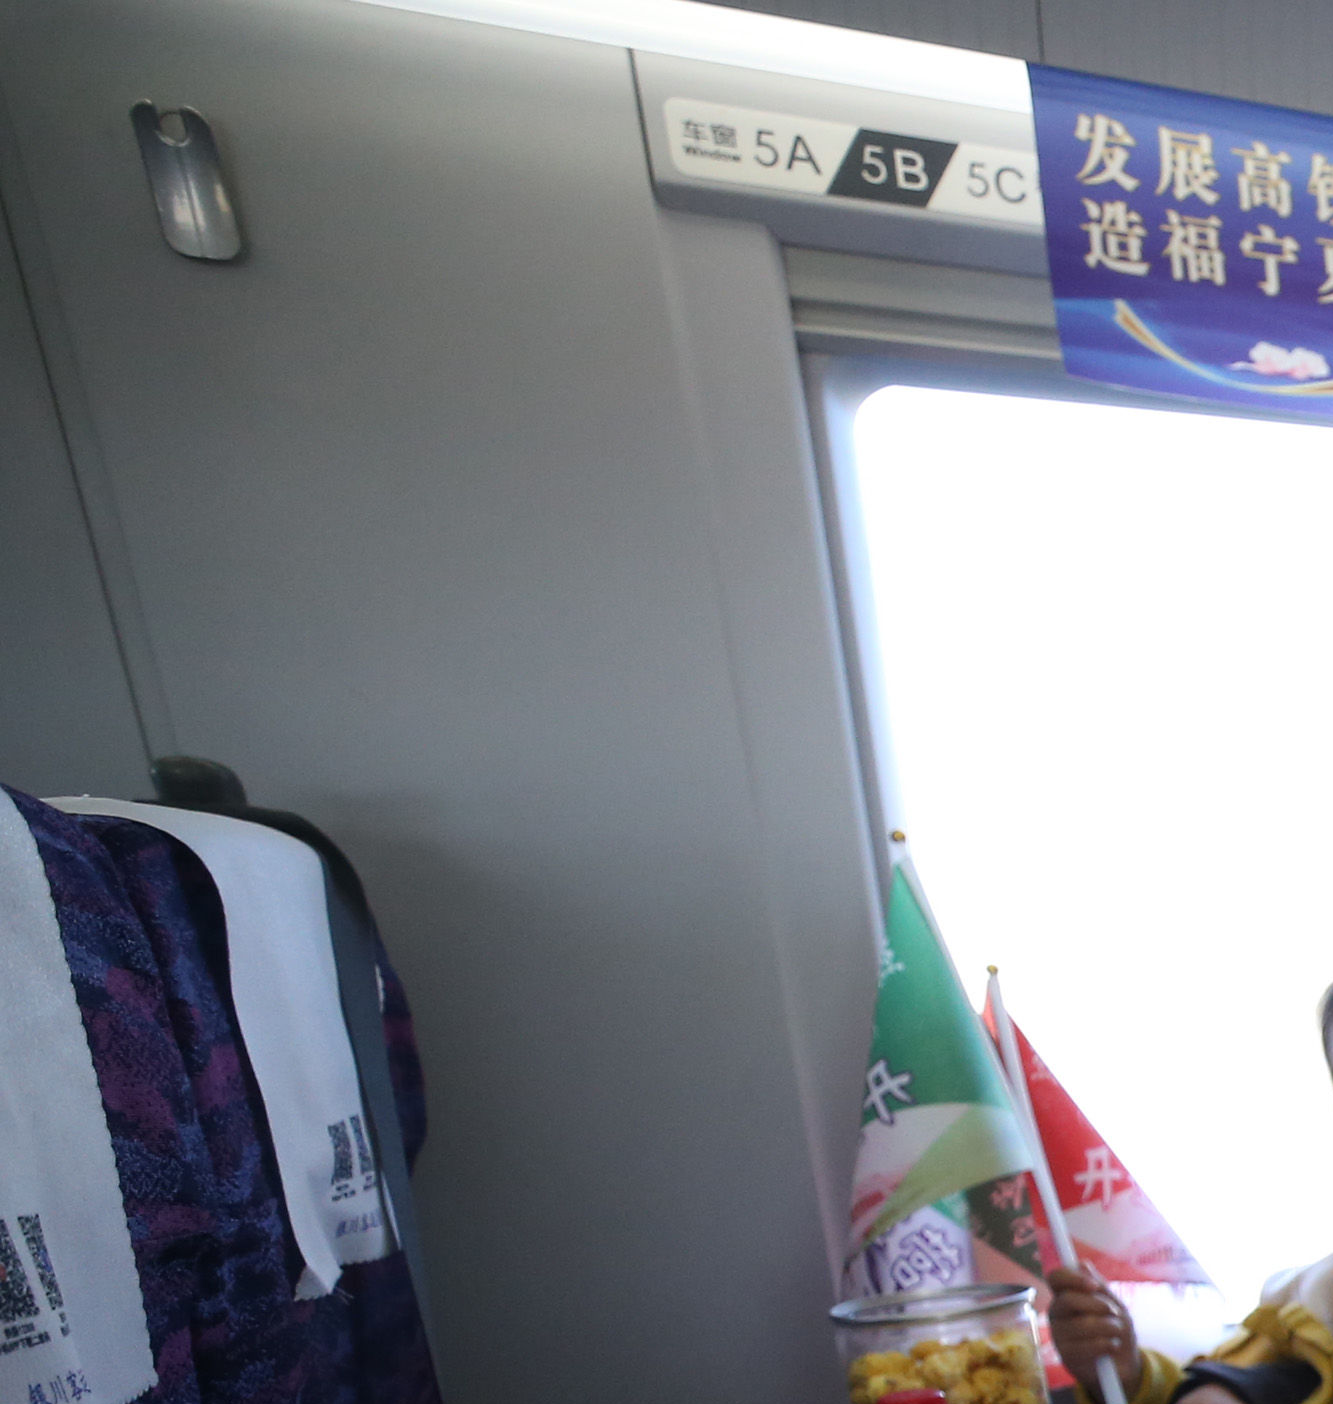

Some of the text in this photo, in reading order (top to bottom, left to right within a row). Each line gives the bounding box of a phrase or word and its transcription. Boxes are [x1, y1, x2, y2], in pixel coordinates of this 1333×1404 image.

[681, 118, 738, 148] 车窗
[682, 144, 742, 163] Window
[755, 129, 1027, 204] 5A 5B 5C
